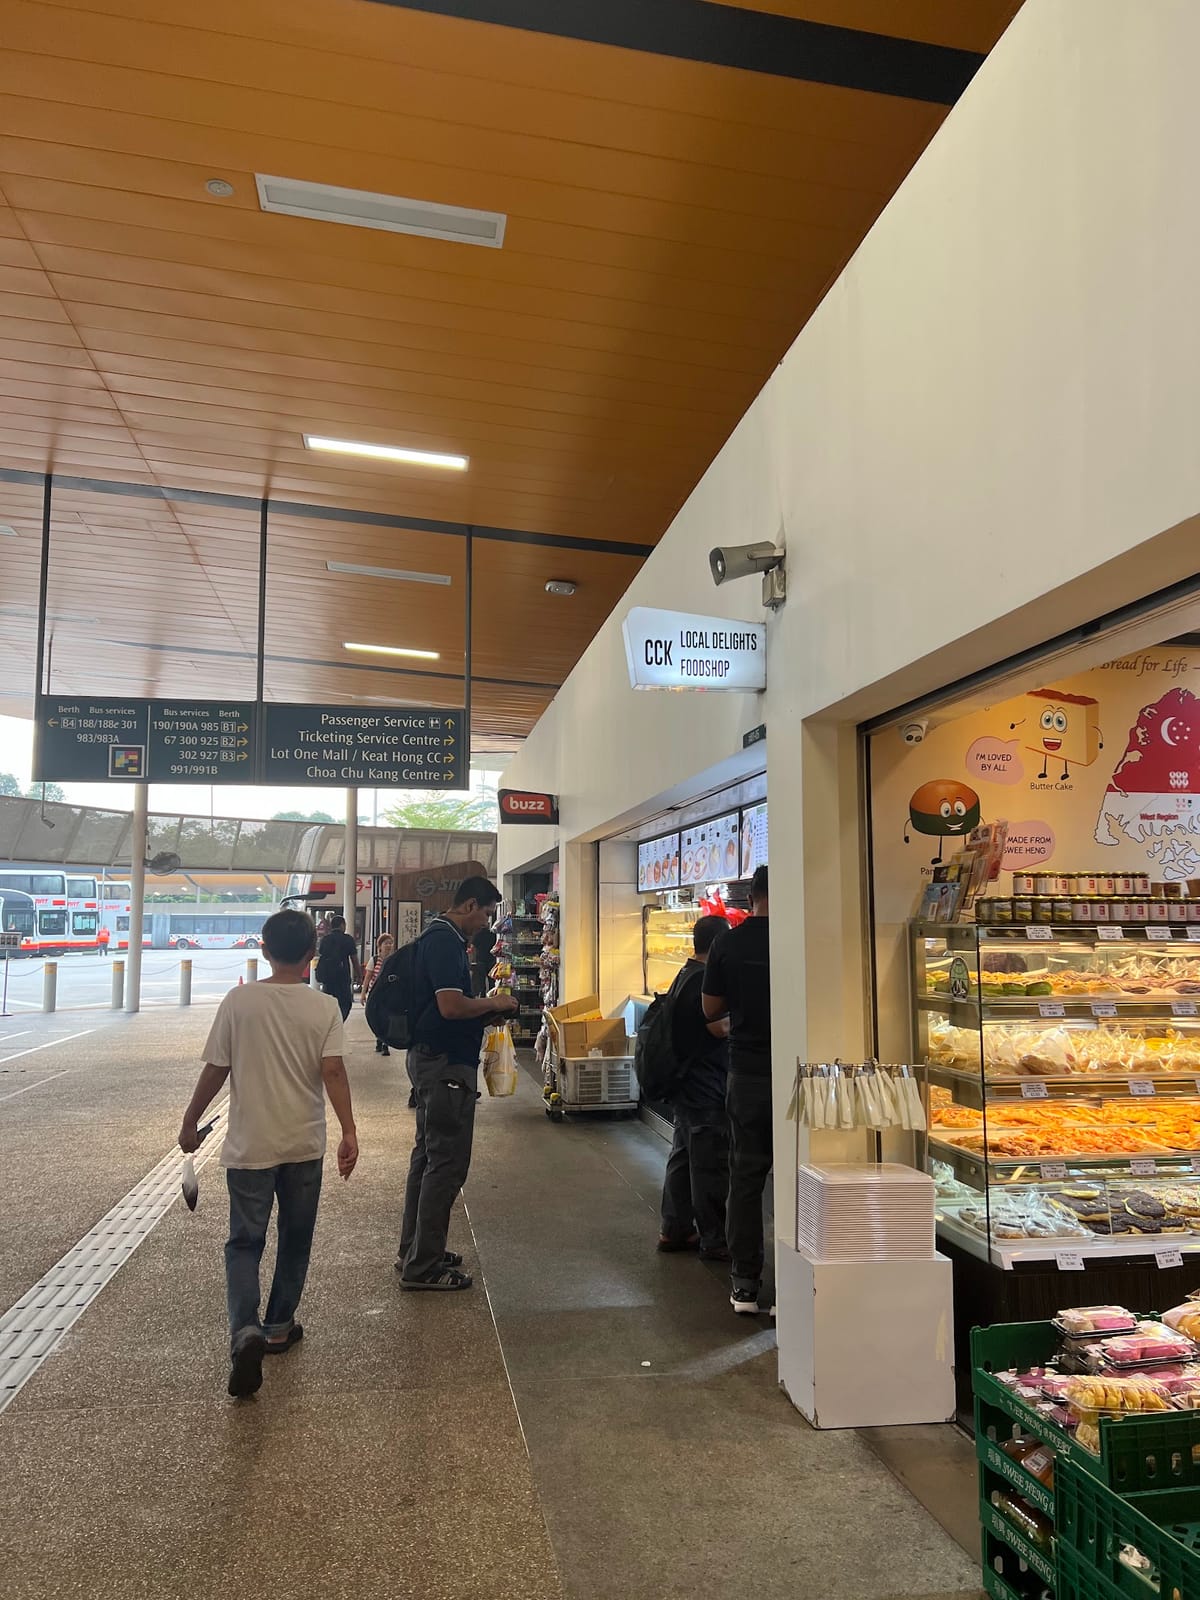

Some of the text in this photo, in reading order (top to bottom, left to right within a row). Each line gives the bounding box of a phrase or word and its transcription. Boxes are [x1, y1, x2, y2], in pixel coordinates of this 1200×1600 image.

[680, 630, 758, 651] LOCAL DELIGHTS
[644, 638, 673, 666] CCK
[680, 658, 730, 678] FOODSHOP
[1136, 655, 1160, 677] for
[1161, 656, 1188, 678] Life
[58, 705, 80, 713] Berth
[89, 706, 136, 715] Bus services
[163, 708, 210, 717] Bus services
[219, 710, 240, 718] Berth
[62, 718, 75, 728] B4
[121, 720, 137, 729] 301
[152, 720, 235, 732] 190/190A 985 B1
[321, 713, 425, 729] Passenger Service
[76, 733, 120, 744] 983/983A
[164, 735, 234, 746] 67 300 925 B2
[298, 730, 441, 746] Ticketing Service Centre
[179, 750, 234, 761] 302 927 B3
[271, 747, 290, 759] Lot
[293, 748, 319, 760] One
[322, 748, 348, 761] Mall
[361, 750, 388, 762] Keat
[392, 751, 423, 766] Hong
[426, 752, 442, 763] CC
[987, 754, 1012, 762] LOVED
[170, 764, 219, 775] 991/991B
[981, 763, 1007, 772] BY ALL
[306, 766, 440, 783] Choa Chu Kang Centre
[1030, 782, 1074, 791] Butter Cake
[509, 796, 545, 810] buzz
[1007, 836, 1052, 844] MADE FROM
[1025, 846, 1046, 855] HENG
[1002, 1461, 1025, 1489] SWEE
[1024, 1480, 1049, 1512] HENG
